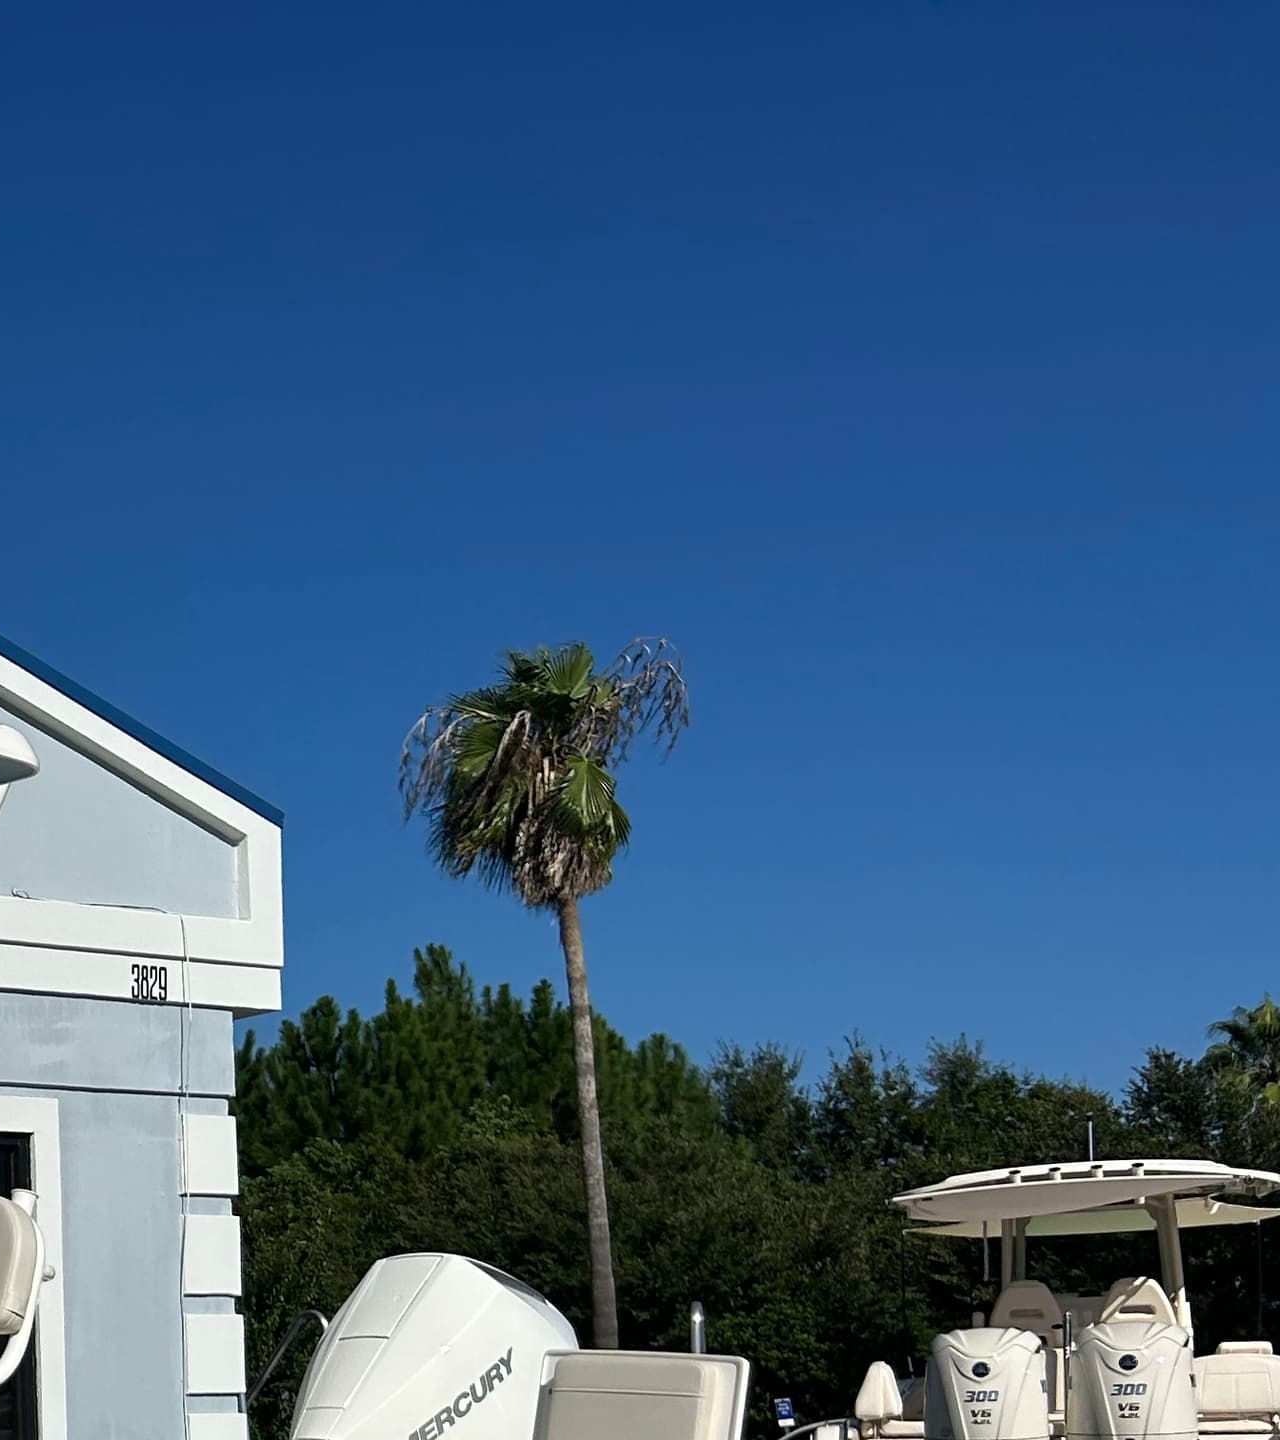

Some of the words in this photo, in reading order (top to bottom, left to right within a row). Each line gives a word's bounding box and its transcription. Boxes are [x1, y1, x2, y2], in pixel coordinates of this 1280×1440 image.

[131, 964, 168, 1001] 3829
[1110, 1383, 1148, 1396] 300
[963, 1390, 999, 1403] 300
[970, 1408, 992, 1418] V6
[1118, 1402, 1140, 1412] V6
